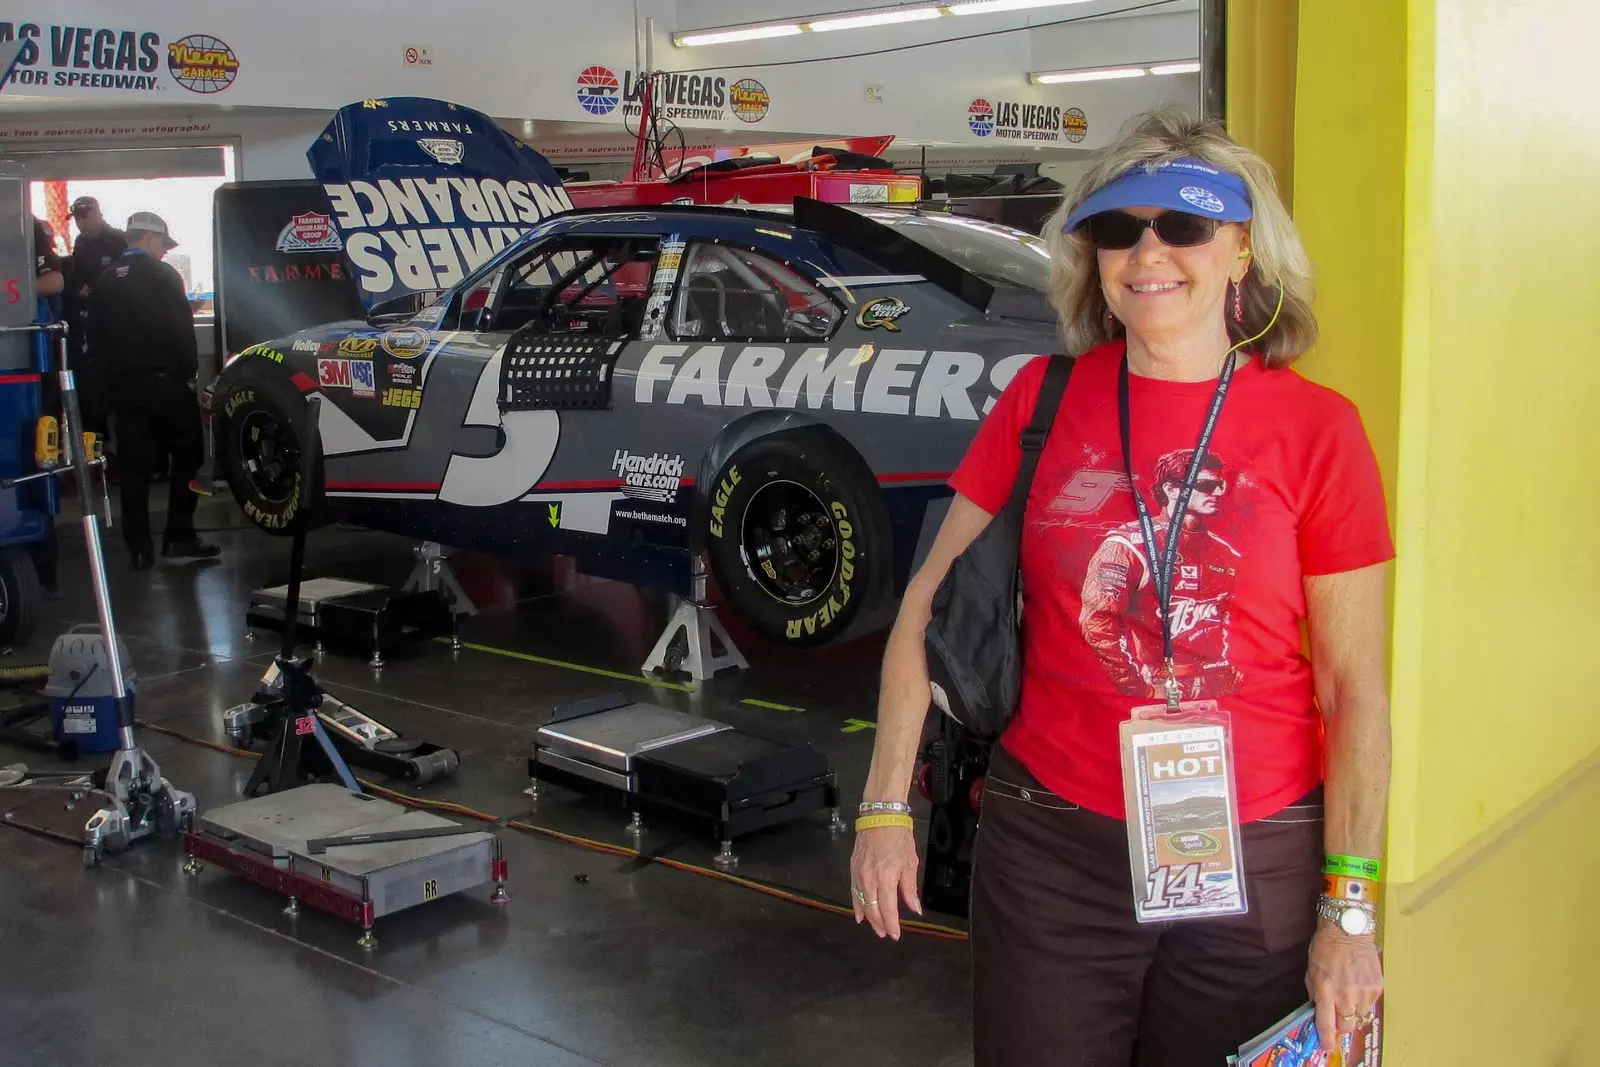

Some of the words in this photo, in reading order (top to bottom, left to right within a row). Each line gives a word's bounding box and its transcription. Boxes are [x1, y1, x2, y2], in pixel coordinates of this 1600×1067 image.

[50, 25, 161, 73] VEGAS
[54, 71, 158, 91] SPEEDWAY
[181, 67, 226, 80] GARAGE
[622, 70, 660, 104] LA
[664, 73, 726, 108] VEGAS
[666, 107, 725, 121] SPEEDWAY
[995, 101, 1019, 128] LAS
[1022, 104, 1060, 131] VEGAS
[386, 119, 473, 135] FARMERS
[995, 128, 1021, 140] MOTOR
[1023, 131, 1059, 141] SPEEDWAY
[322, 177, 576, 230] INSURANCE
[302, 231, 322, 239] GROUP
[869, 303, 912, 315] QUAKER
[872, 309, 900, 319] STATE
[292, 339, 320, 356] Holley
[320, 361, 350, 387] 3M
[351, 361, 372, 387] USG
[224, 390, 256, 419] EAGLE
[382, 387, 422, 409] JEGS
[611, 449, 684, 478] Hendrick
[625, 473, 679, 490] cars.com
[709, 464, 742, 539] EAGLE
[615, 509, 687, 527] www.bethematch.org
[433, 560, 441, 574] 5
[785, 500, 857, 639] GOODYEAR
[1139, 755, 1149, 795] SPEEDWAY
[1153, 756, 1221, 779] HOT
[1143, 795, 1151, 825] MOTOR
[1146, 825, 1154, 854] VEGAS
[425, 880, 437, 898] RR
[1142, 862, 1204, 911] 14
